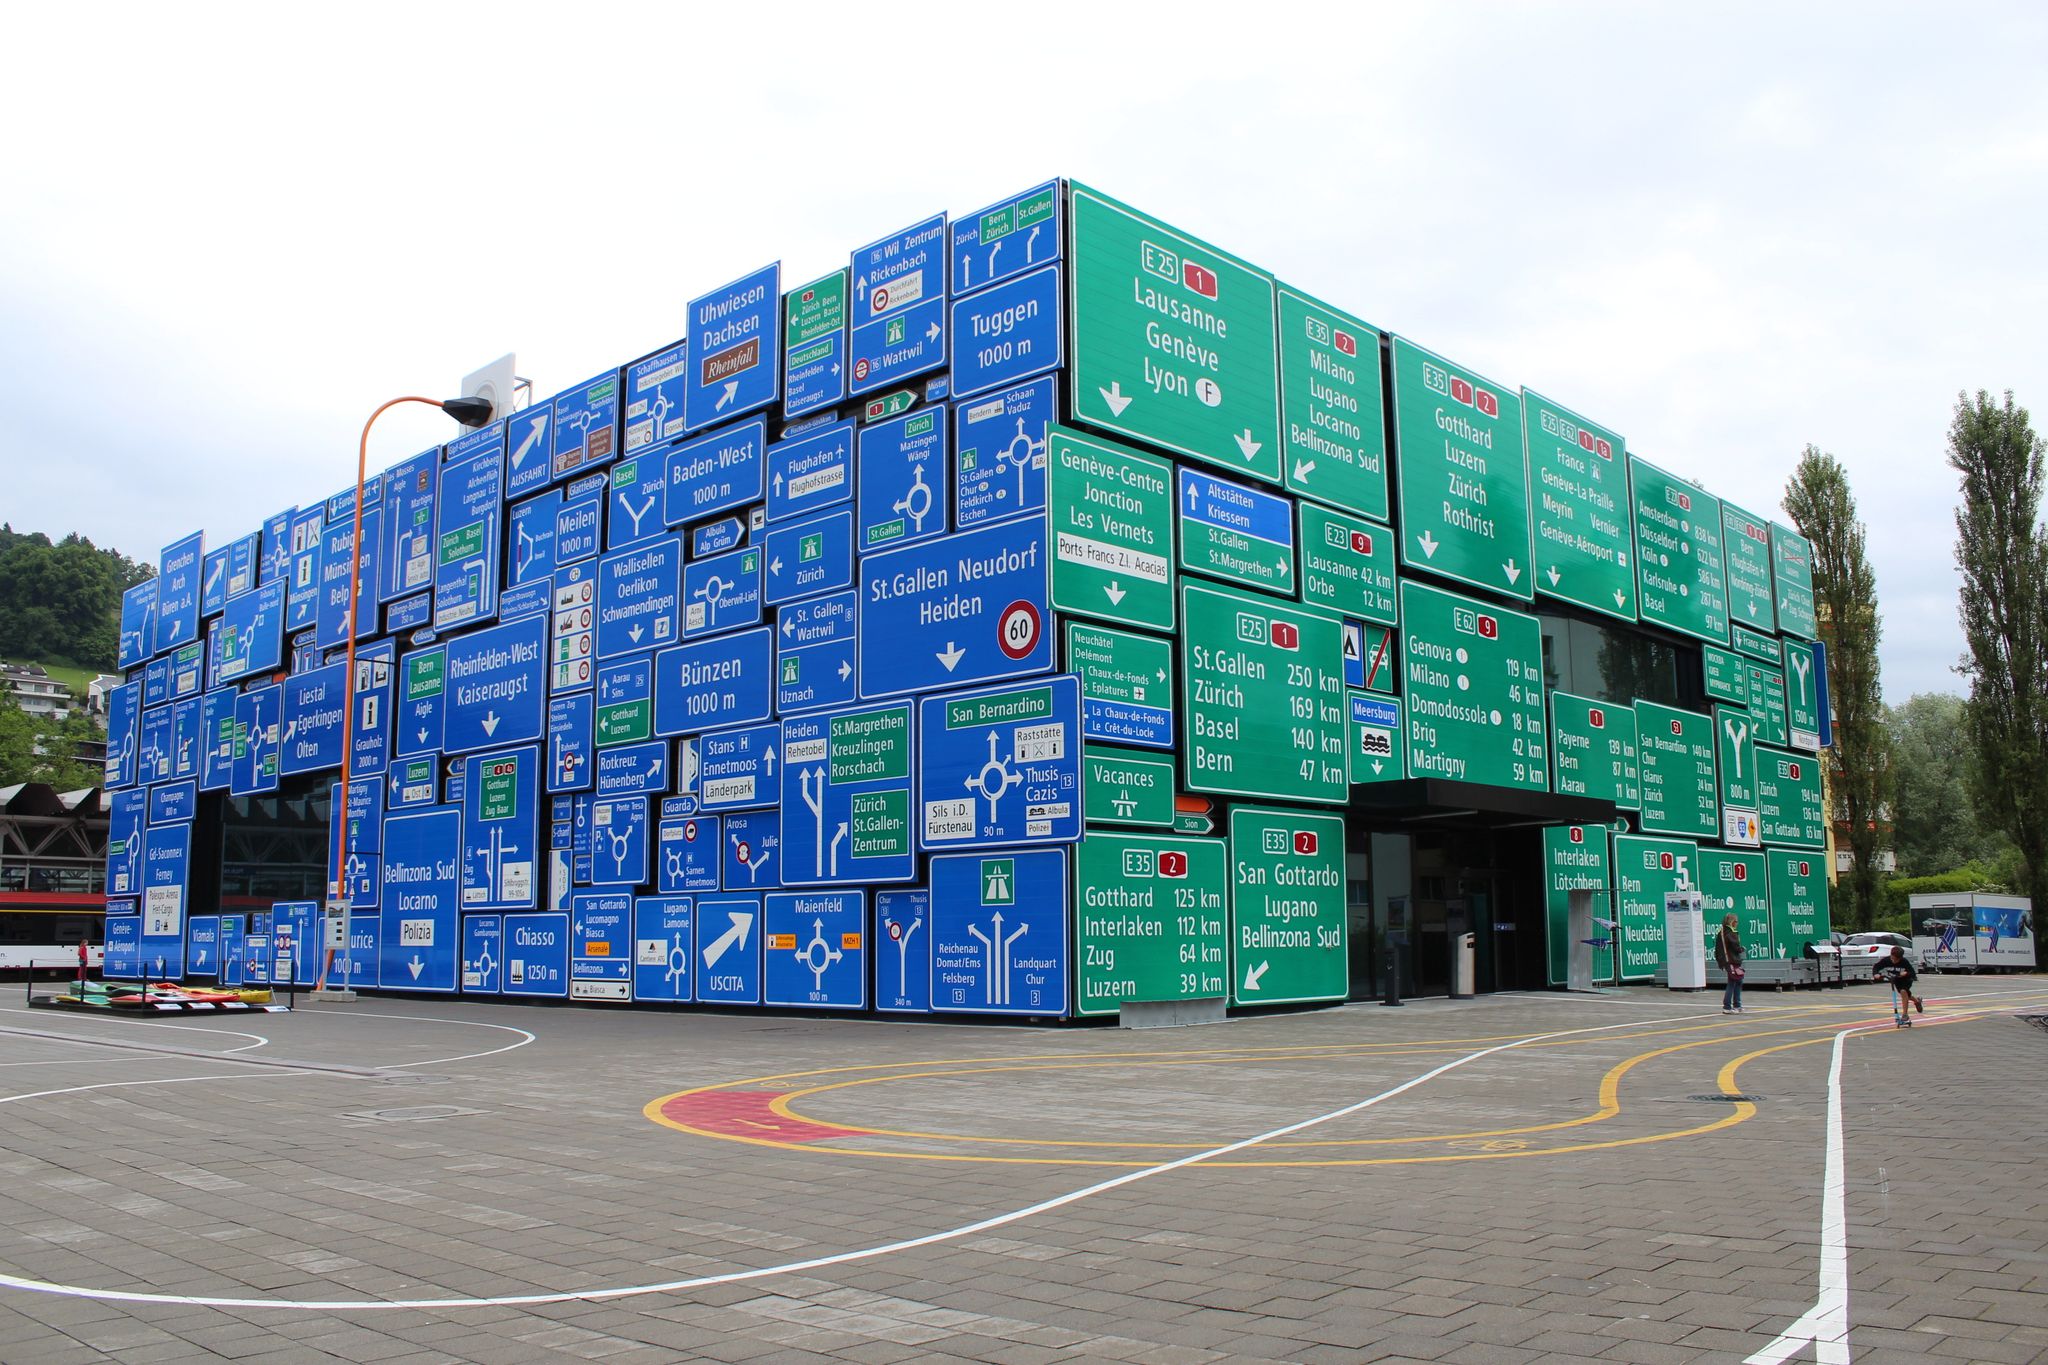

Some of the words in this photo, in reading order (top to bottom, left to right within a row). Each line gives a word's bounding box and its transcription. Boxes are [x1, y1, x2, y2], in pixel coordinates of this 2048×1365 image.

[905, 226, 942, 250] Zentrum
[870, 251, 927, 284] Rickenbach
[1196, 269, 1203, 291] 1
[700, 285, 764, 325] Uhwiesen
[1134, 276, 1228, 339] Lausanne
[971, 300, 1038, 337] Tuggen
[704, 315, 759, 350] Dachsen
[791, 345, 828, 366] Deutschland
[883, 341, 923, 368] Wattwil
[978, 342, 1012, 368] 1000
[1018, 339, 1031, 356] m
[1146, 321, 1219, 372] Genève
[708, 346, 753, 379] Rheinfall
[1309, 349, 1355, 385] Milano
[1144, 356, 1188, 397] Lyon
[1204, 381, 1214, 403] F
[1007, 389, 1035, 404] Schaan
[1309, 378, 1358, 414] Lugano
[1007, 402, 1031, 416] Vaduz
[1309, 404, 1361, 441] Locarno
[1436, 407, 1492, 450] Gotthard
[900, 435, 938, 452] Matzingen
[1291, 423, 1353, 463] Bellinzona
[1358, 449, 1379, 471] Sud
[673, 440, 753, 484] Baden-West
[788, 449, 834, 475] Flughafen
[907, 450, 930, 463] Wängi
[1445, 440, 1486, 476] Luzern
[1556, 448, 1585, 474] France
[510, 463, 547, 488] AUSFAHRT
[615, 465, 635, 484] Basel
[790, 470, 843, 494] Flughofstrasse
[1061, 448, 1164, 495] Genève-Centre
[569, 477, 601, 497] Glattfelden
[1207, 484, 1254, 509] Altstätten
[1448, 472, 1487, 506] Zürich
[1084, 484, 1143, 515] Jonction
[560, 509, 595, 532] Meilen
[960, 509, 986, 522] Eschen
[1070, 506, 1093, 529] Les
[1100, 514, 1154, 545] Vernets
[1207, 504, 1250, 529] Kriessern
[1443, 501, 1494, 539] Rothrist
[1542, 492, 1574, 520] Meyrin
[1590, 512, 1620, 539] Vernier
[1639, 501, 1679, 531] Amsterdam
[561, 537, 581, 555] 1000
[583, 534, 592, 547] m
[1208, 529, 1249, 552] St.Gallen
[1540, 520, 1614, 562] Genève-Aéroport
[1640, 524, 1678, 552] Düsseldorf
[166, 551, 194, 574] Grenchen
[613, 552, 665, 578] Wallisellen
[1059, 538, 1084, 558] Ports
[1087, 544, 1115, 566] Francs
[1134, 556, 1167, 577] Acacias
[1208, 549, 1273, 579] St.Margrethen
[1641, 546, 1658, 565] Köln
[871, 567, 948, 602] St.Gallen
[958, 541, 1038, 583] Neudorf
[1307, 551, 1358, 581] Lausanne
[1360, 568, 1373, 587] 42
[1376, 568, 1392, 590] km
[1643, 569, 1677, 594] Karlsruhe
[171, 575, 186, 592] Arch
[618, 576, 658, 598] Oerlikon
[1308, 575, 1335, 598] Orbe
[330, 588, 349, 607] Belp
[602, 593, 674, 624] Schwamendingen
[1644, 593, 1665, 614] Basel
[920, 595, 982, 625] Heiden
[1010, 618, 1028, 641] 60
[1075, 632, 1114, 649] Neuchâtel
[451, 640, 538, 679] Rheinfelden-West
[1075, 648, 1112, 665] Delémont
[1409, 635, 1452, 662] Genova
[681, 658, 742, 688] Bünzen
[1193, 646, 1266, 680] St.Gallen
[1287, 664, 1313, 688] 250
[1318, 668, 1340, 694] km
[1410, 662, 1450, 688] Milano
[299, 684, 326, 706] Liestal
[410, 677, 441, 694] Lausanne
[457, 673, 528, 706] Kaiseraugst
[781, 687, 814, 704] Uznach
[1092, 682, 1129, 698] Eplatures
[1194, 678, 1245, 709] Zürich
[415, 702, 433, 718] Aigle
[686, 692, 718, 716] 1000
[723, 693, 736, 710] m
[952, 707, 973, 723] San
[979, 698, 1045, 719] Bernardino
[1354, 701, 1396, 725] Meersburg
[1412, 693, 1487, 726] Domodossola
[298, 708, 343, 732] Egerkingen
[786, 724, 818, 739] Heiden
[1195, 713, 1240, 741] Basel
[1017, 728, 1061, 742] Raststätte
[1412, 721, 1436, 748] Brig
[1558, 728, 1590, 749] Payerne
[1641, 734, 1652, 747] San
[1655, 736, 1687, 754] Bernardino
[297, 741, 319, 759] Olten
[709, 740, 735, 755] Stans
[787, 741, 825, 758] Rehetobel
[832, 739, 894, 758] Kreuzlingen
[1642, 752, 1656, 766] Chur
[601, 755, 637, 770] Rotkreuz
[703, 758, 757, 776] Ennetmoos
[832, 758, 885, 777] Rorschach
[1196, 746, 1233, 773] Bern
[1299, 759, 1315, 782] 47
[1321, 760, 1343, 784] km
[1414, 749, 1466, 778] Martigny
[1560, 752, 1578, 770] Bern
[1026, 766, 1058, 782] Thusis
[1093, 764, 1154, 788] Vacances
[1561, 776, 1586, 793] Aarau
[1643, 770, 1663, 784] Glarus
[160, 792, 184, 804] Champagne
[705, 779, 753, 799] Länderpark
[664, 800, 691, 813] Guarda
[727, 818, 747, 829] Arosa
[928, 818, 972, 835] Fürstenau
[1184, 819, 1198, 830] Sion
[1554, 848, 1600, 868] Interlaken
[156, 869, 173, 883] Ferney
[385, 863, 432, 883] Bellinzona
[436, 859, 455, 881] Sud
[1238, 862, 1266, 885] San
[1274, 863, 1339, 887] Gottardo
[1554, 873, 1602, 890] Lötschberg
[1675, 856, 1688, 890] 5
[399, 892, 438, 911] Locarno
[795, 898, 842, 914] Maienfeld
[1086, 886, 1154, 908] Gotthard
[1174, 888, 1195, 908] 125
[1200, 888, 1220, 909] km
[1702, 894, 1724, 910] Milano
[586, 913, 619, 925] Lucomagno
[664, 903, 687, 916] Lugano
[1264, 896, 1318, 924] Lugano
[1624, 900, 1656, 920] Fribourg
[404, 924, 431, 940] Polizia
[663, 918, 689, 928] Lamone
[1086, 915, 1162, 937] Interlaken
[1626, 924, 1664, 942] Neuchâtel
[193, 930, 214, 943] Viamala
[516, 927, 555, 946] Chiasso
[1242, 926, 1310, 949] Bellinzona
[1317, 924, 1340, 948] Sud
[939, 943, 978, 955] Reichenau
[1086, 945, 1114, 970] Zug
[1626, 949, 1658, 966] Yverdon
[528, 964, 547, 980] 1250
[550, 967, 558, 980] m
[936, 956, 981, 969] Domat/Ems
[1013, 957, 1057, 971] Landquart
[710, 975, 744, 991] USCITA
[942, 971, 975, 987] Felsberg
[1086, 977, 1136, 998] Luzern
